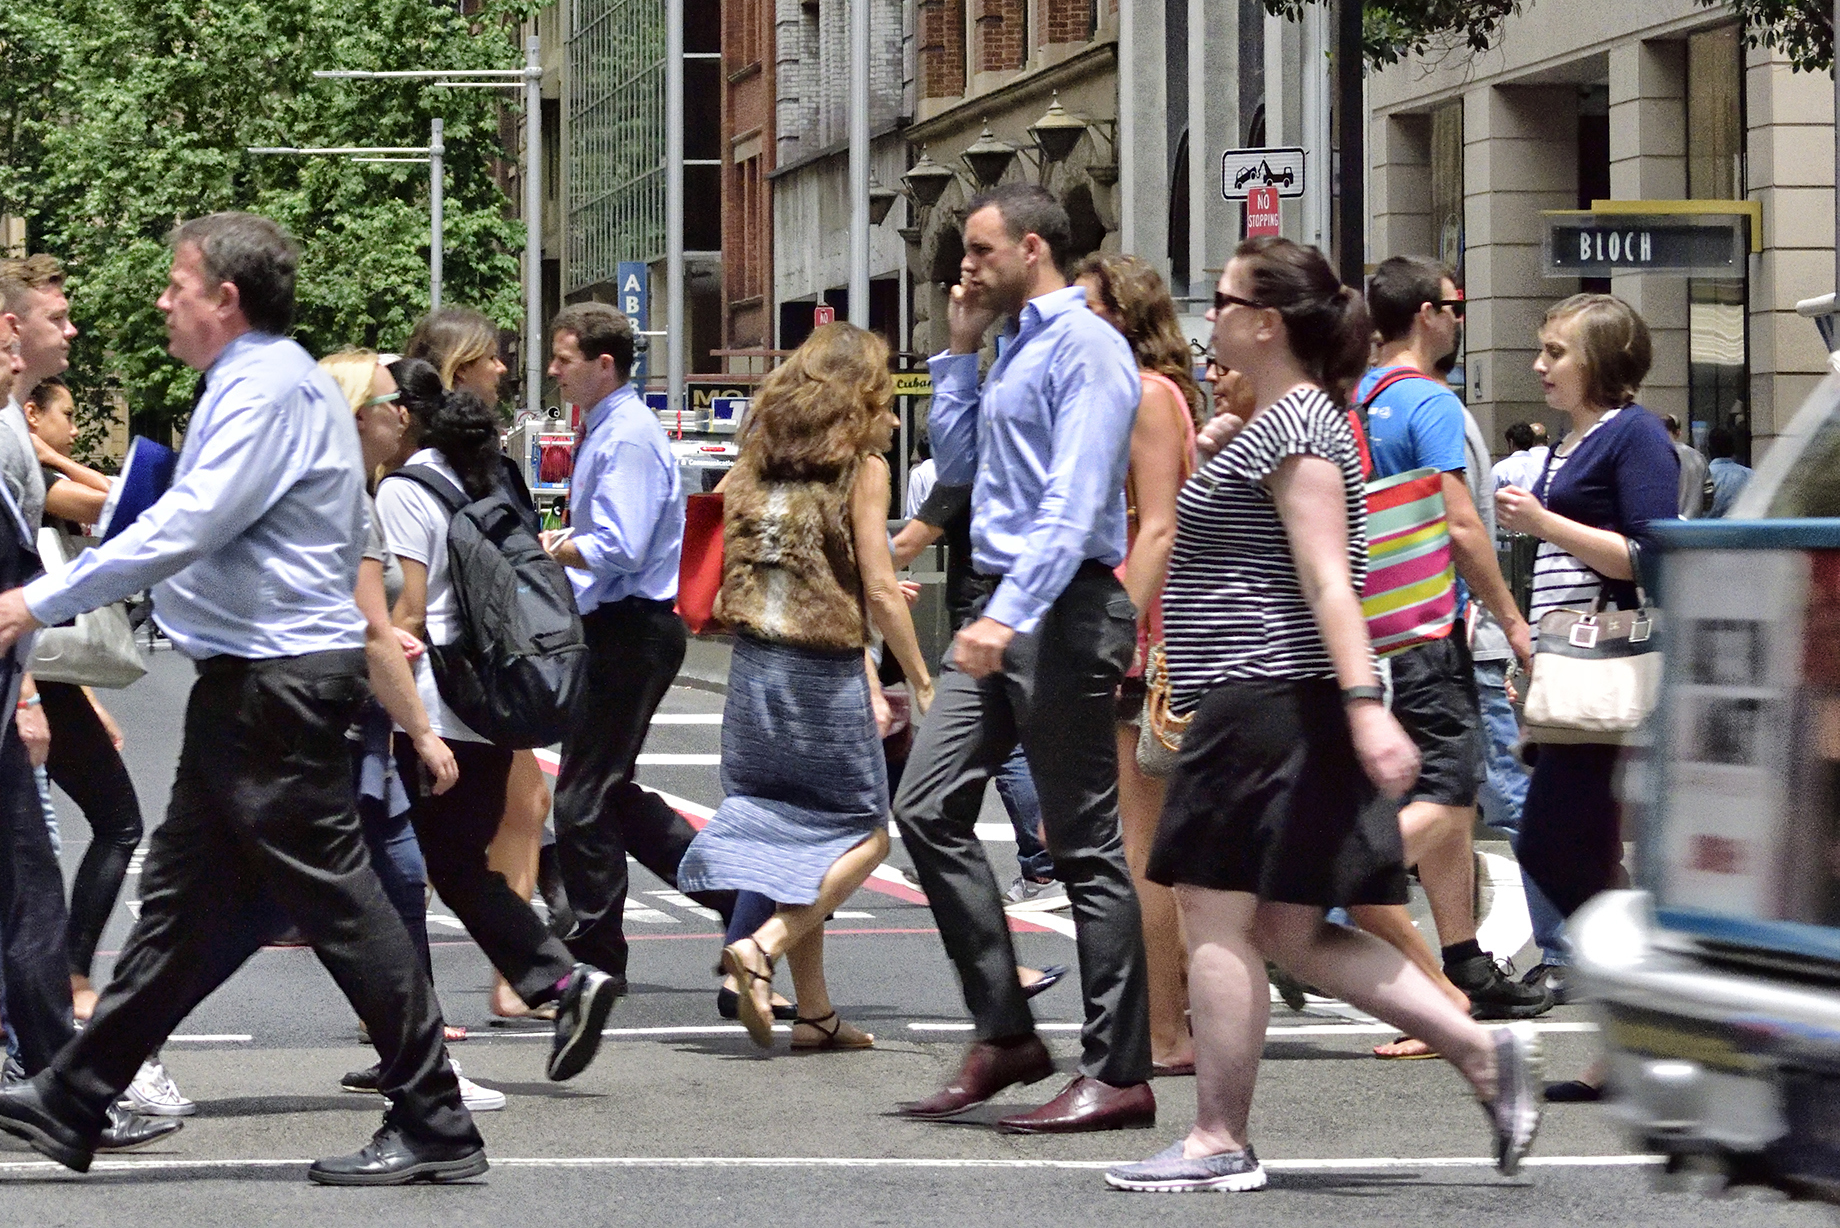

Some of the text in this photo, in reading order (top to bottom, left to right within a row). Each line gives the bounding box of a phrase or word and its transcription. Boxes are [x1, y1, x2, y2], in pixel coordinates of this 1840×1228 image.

[1257, 194, 1269, 210] NO
[1248, 213, 1279, 227] STOPPING
[1580, 231, 1652, 262] BLOCH
